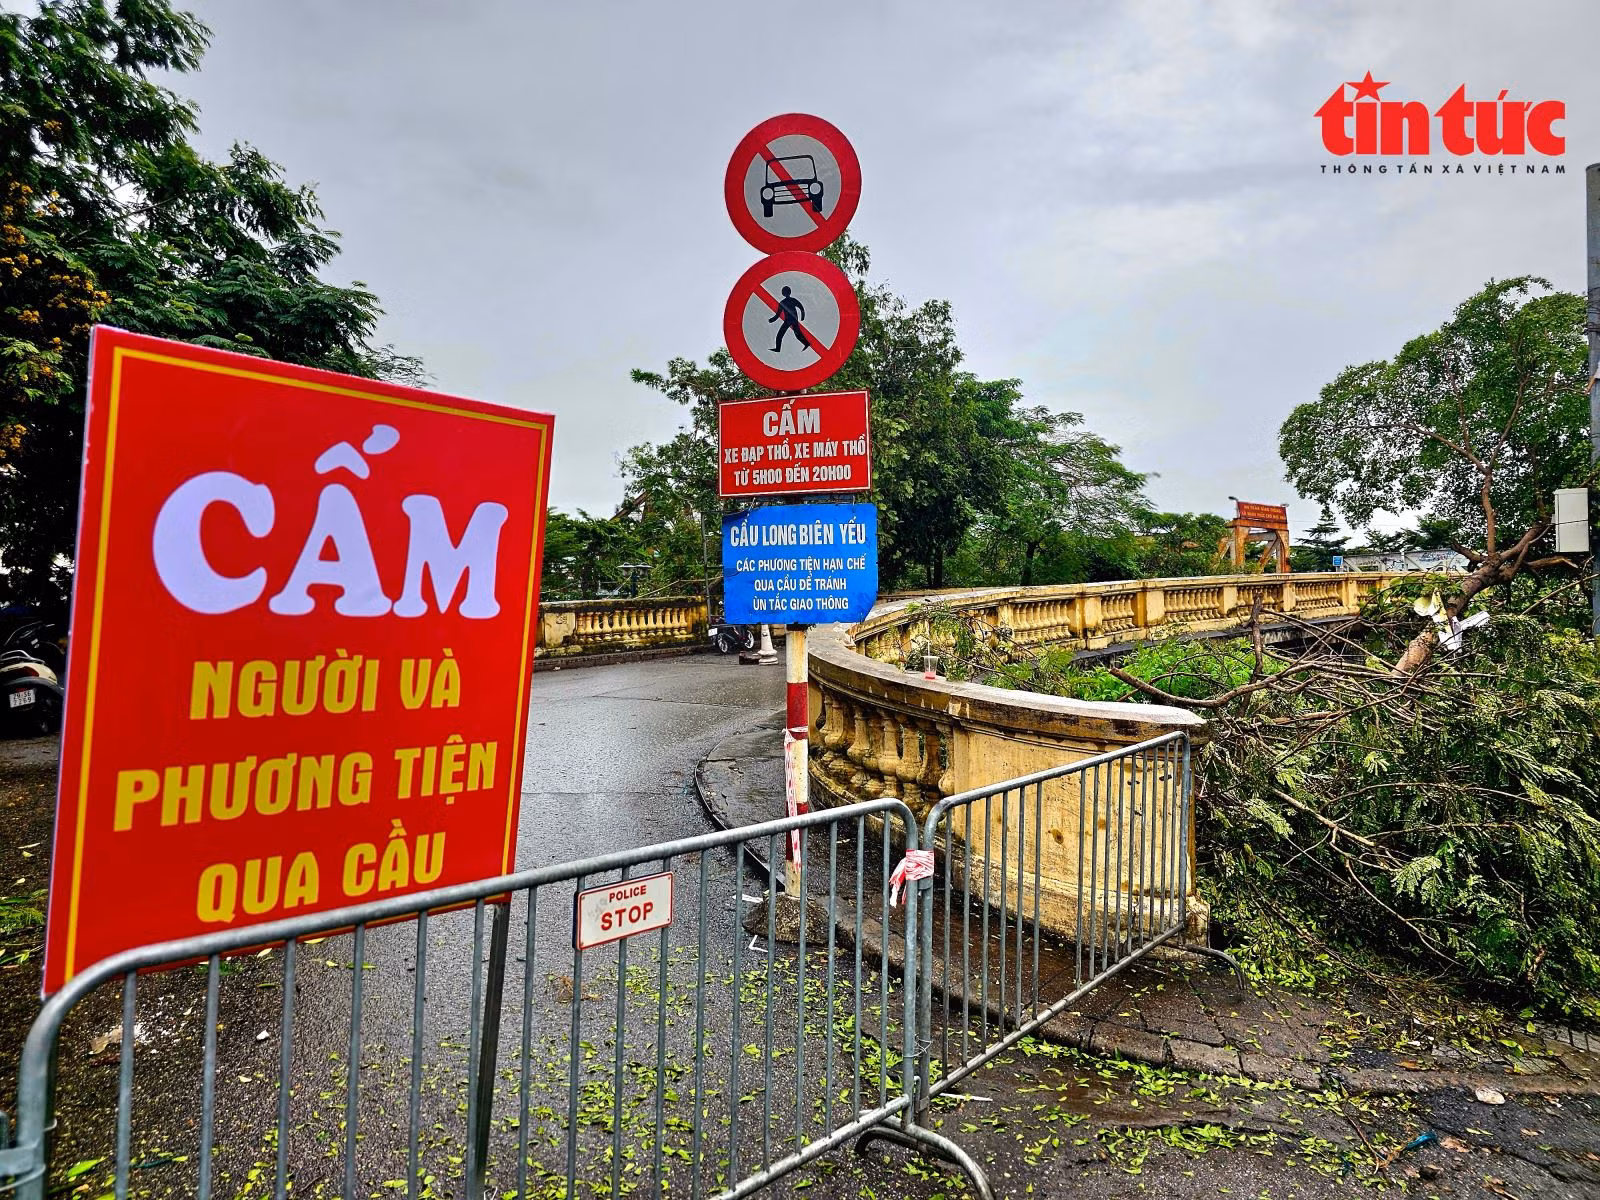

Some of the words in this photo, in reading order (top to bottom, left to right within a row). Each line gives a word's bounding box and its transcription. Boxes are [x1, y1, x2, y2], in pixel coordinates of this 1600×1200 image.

[762, 399, 821, 436] CẤM
[724, 447, 739, 464] XE
[741, 445, 764, 465] ĐẠP
[794, 442, 810, 459] XE
[813, 438, 839, 458] MÁY
[842, 433, 866, 456] THỒ
[734, 468, 750, 487] TỪ
[753, 469, 782, 485] 5H00
[785, 462, 810, 483] ĐẾN
[813, 464, 851, 482] 20H00
[152, 423, 510, 620] CẤM
[730, 517, 759, 547] CẦU
[762, 523, 797, 546] LONG
[799, 519, 834, 545] BIÊN
[839, 516, 866, 544] YẾU
[736, 556, 756, 572] CÁC
[758, 557, 797, 572] PHƯƠNG
[800, 555, 821, 574] TIỆN
[823, 558, 844, 575] HẠN
[846, 553, 867, 570] CHẾ
[754, 578, 775, 592] QUA
[776, 573, 797, 591] CẦU
[798, 572, 812, 591] ĐỂ
[814, 576, 847, 591] TRÁNH
[753, 597, 767, 611] ÙN
[768, 592, 788, 611] TẮC
[790, 598, 813, 610] GIAO
[815, 595, 849, 610] THÔNG
[189, 646, 381, 721] NGƯỜI
[399, 646, 462, 711] VÀ
[112, 750, 373, 834] PHƯƠNG
[393, 733, 499, 806] TIỆN
[196, 850, 320, 925] QUA
[342, 817, 447, 895] CẦU
[608, 885, 647, 902] POLICE
[600, 902, 654, 931] STOP
